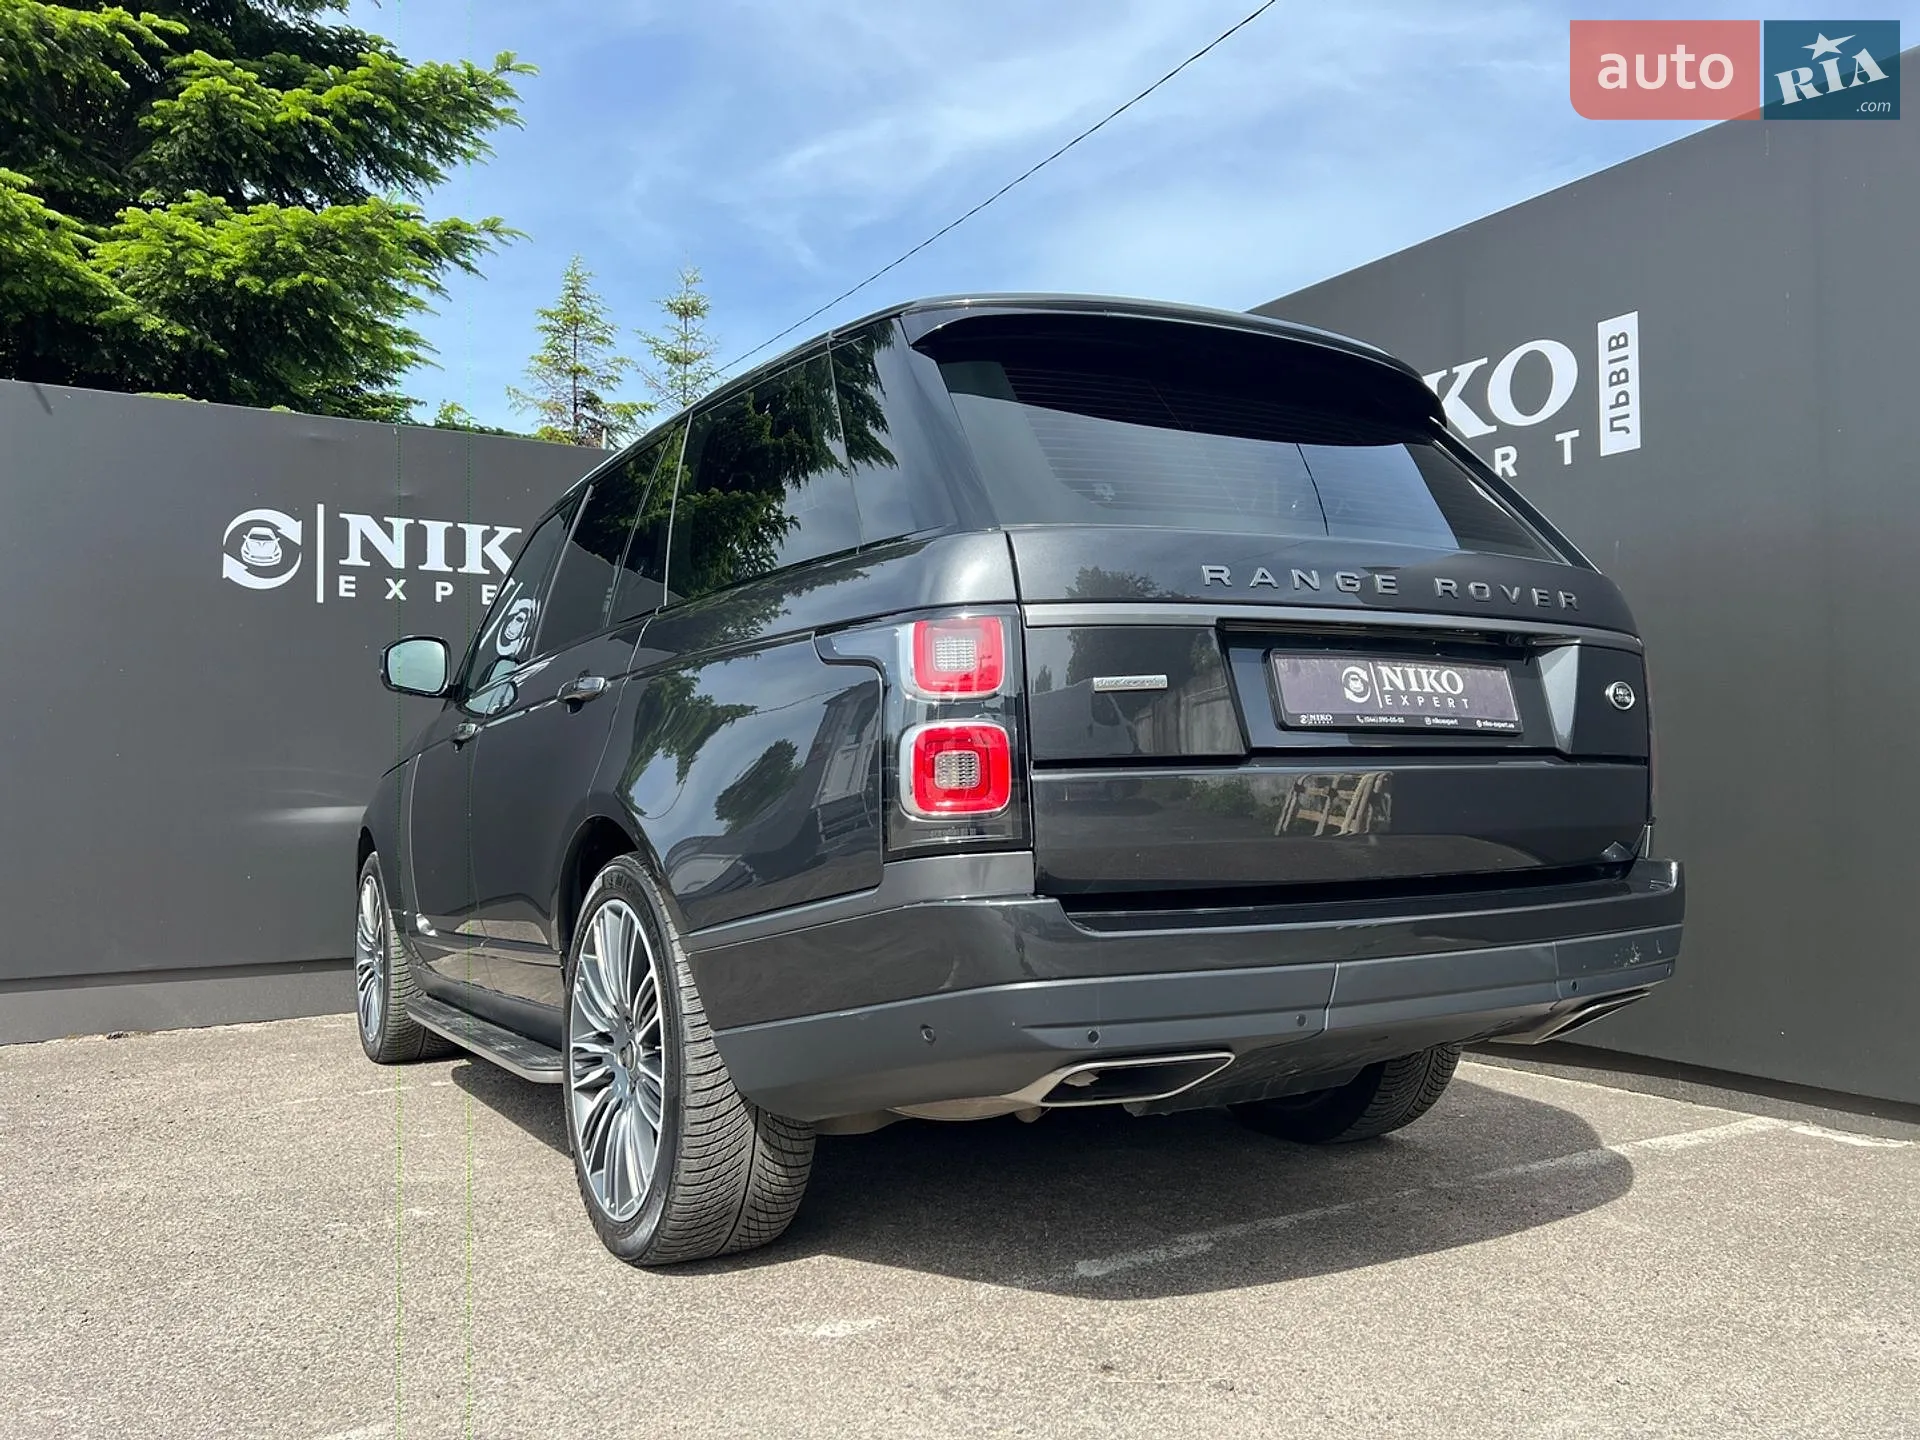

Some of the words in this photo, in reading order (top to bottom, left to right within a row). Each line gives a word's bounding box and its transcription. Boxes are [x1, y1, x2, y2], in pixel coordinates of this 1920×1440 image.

[1422, 339, 1579, 439] KO
[1608, 331, 1630, 434] ЛЬВІВ
[339, 513, 522, 575] NIK
[338, 575, 498, 605] EXPE
[1201, 565, 1398, 595] RANGE
[1436, 577, 1578, 611] ROVER
[1378, 666, 1464, 695] NIKO
[1384, 694, 1470, 709] EXPERT
